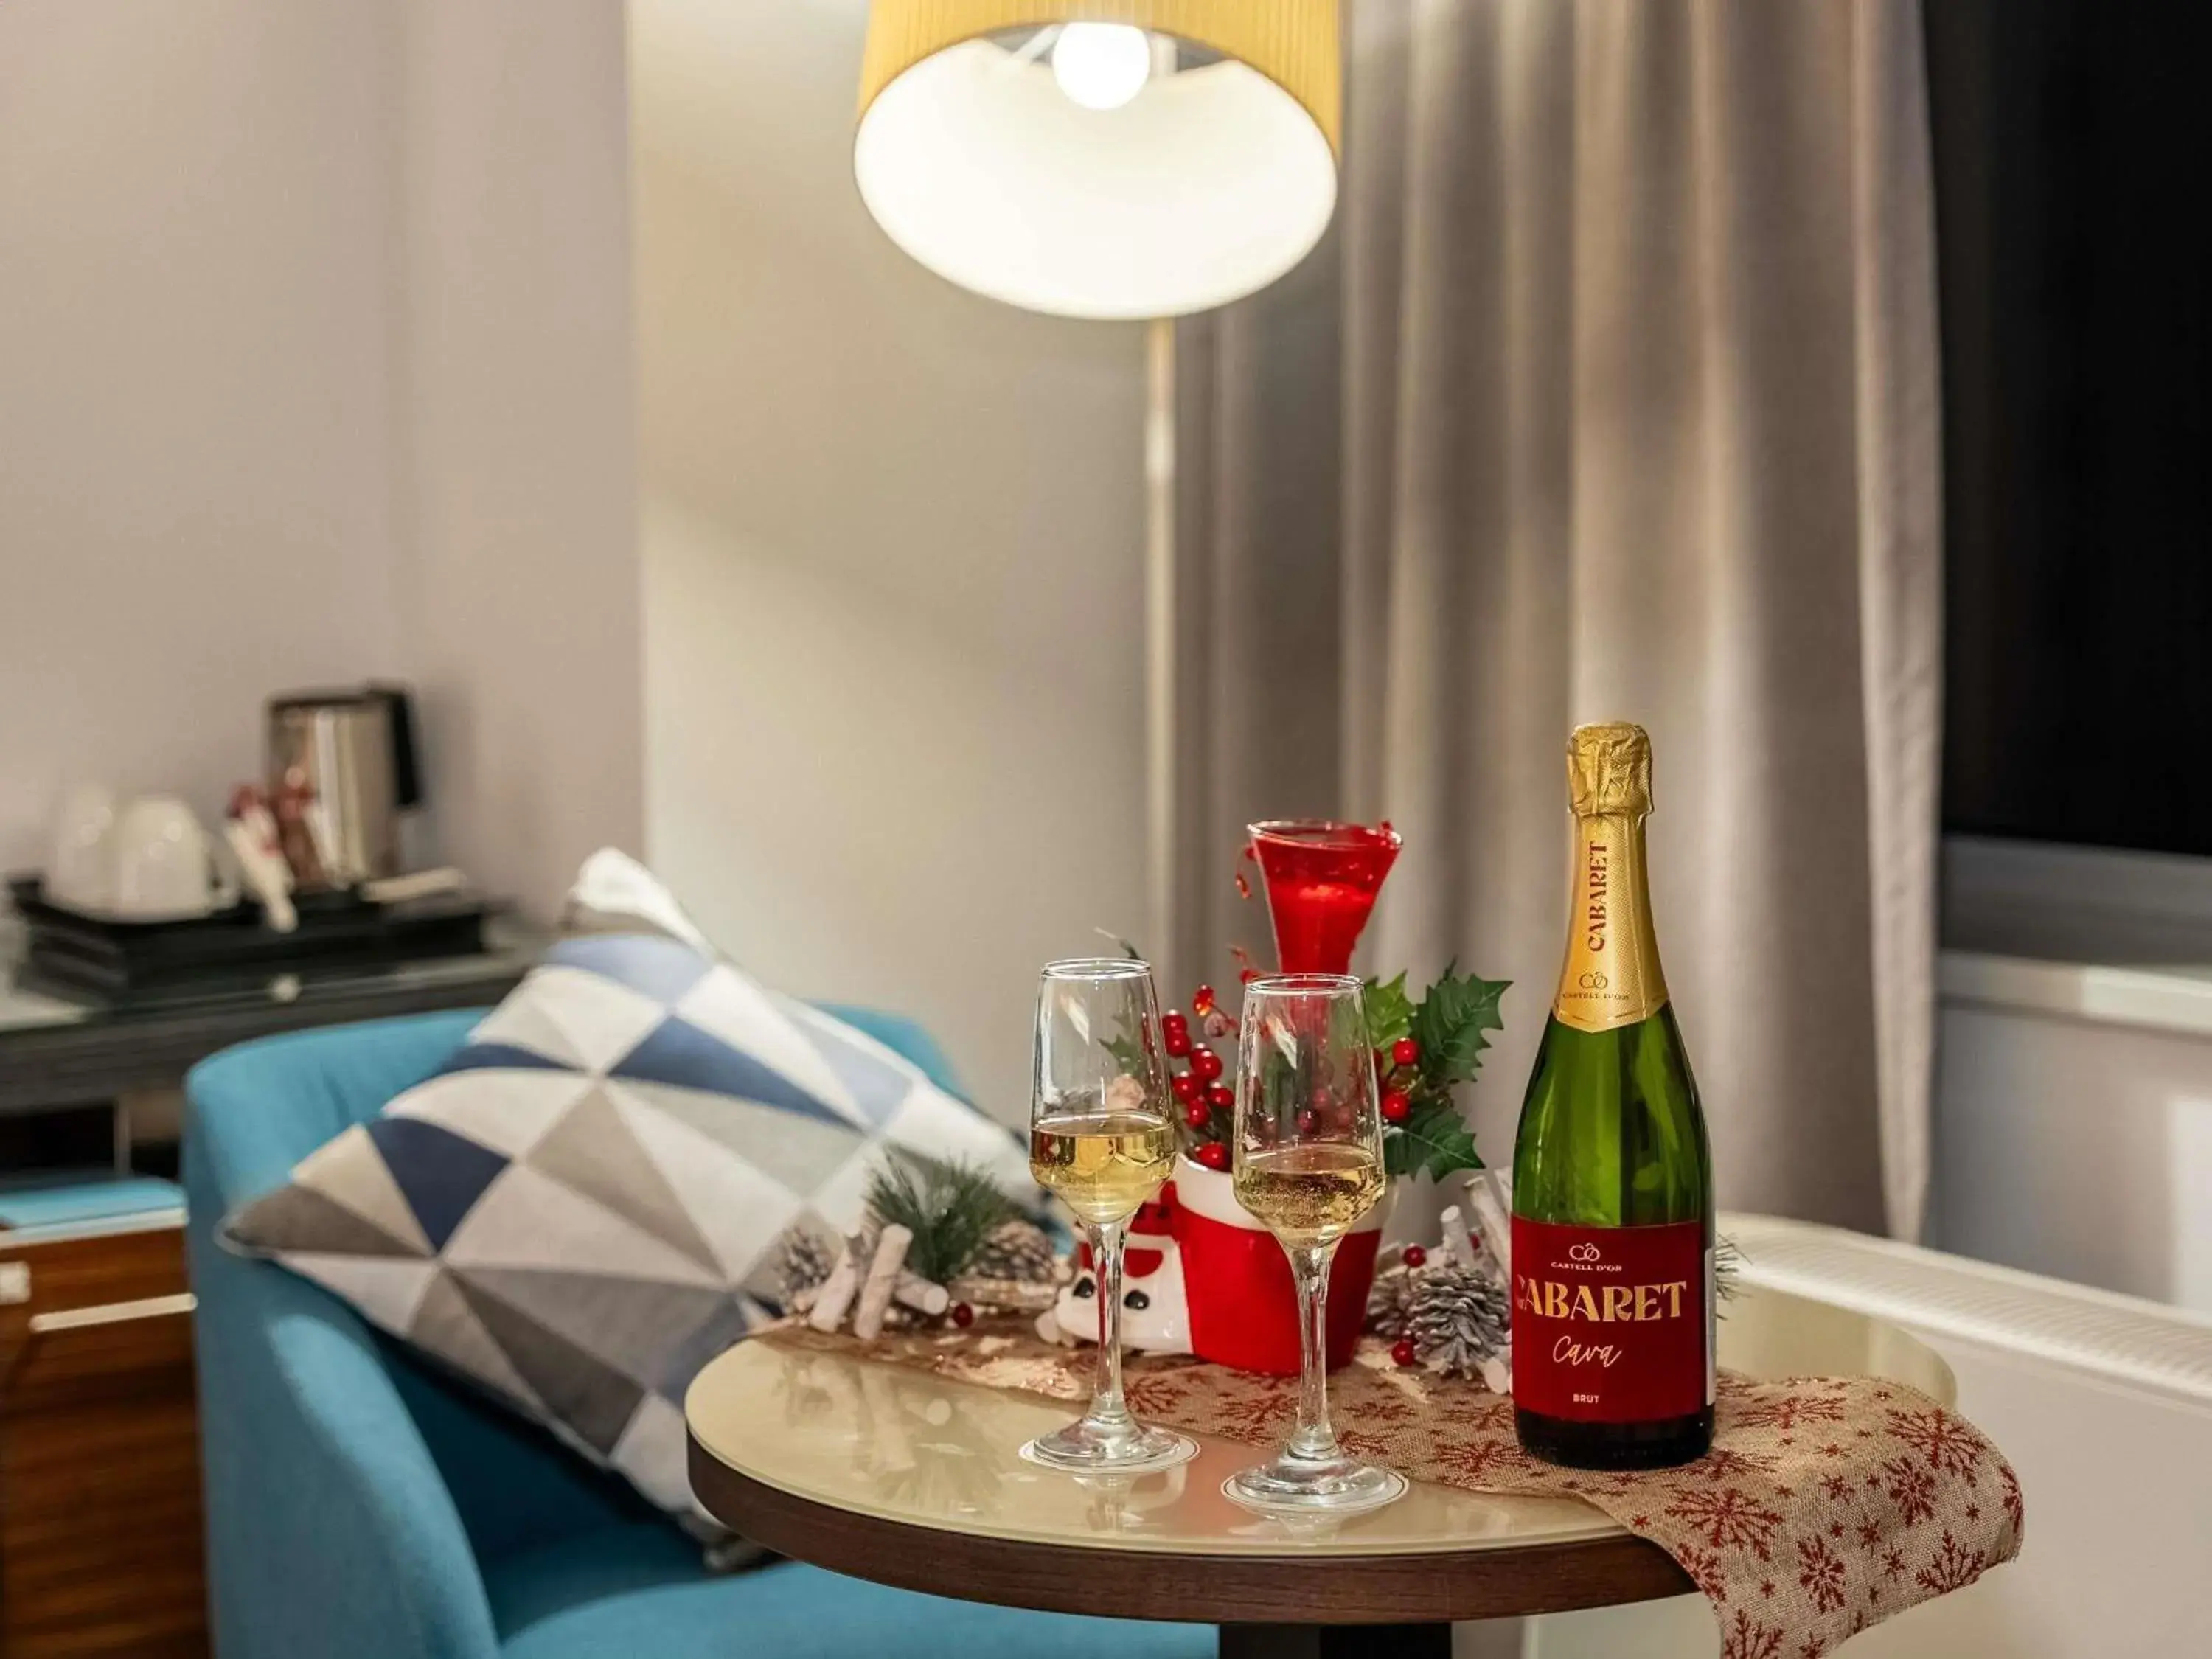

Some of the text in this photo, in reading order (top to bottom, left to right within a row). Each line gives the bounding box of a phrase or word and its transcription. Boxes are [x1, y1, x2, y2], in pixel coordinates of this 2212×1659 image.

[1588, 841, 1607, 952] CABARET
[1551, 1262, 1593, 1270] CASTELL
[1552, 1335, 1622, 1367] Cava
[1573, 1393, 1599, 1404] BRUT
